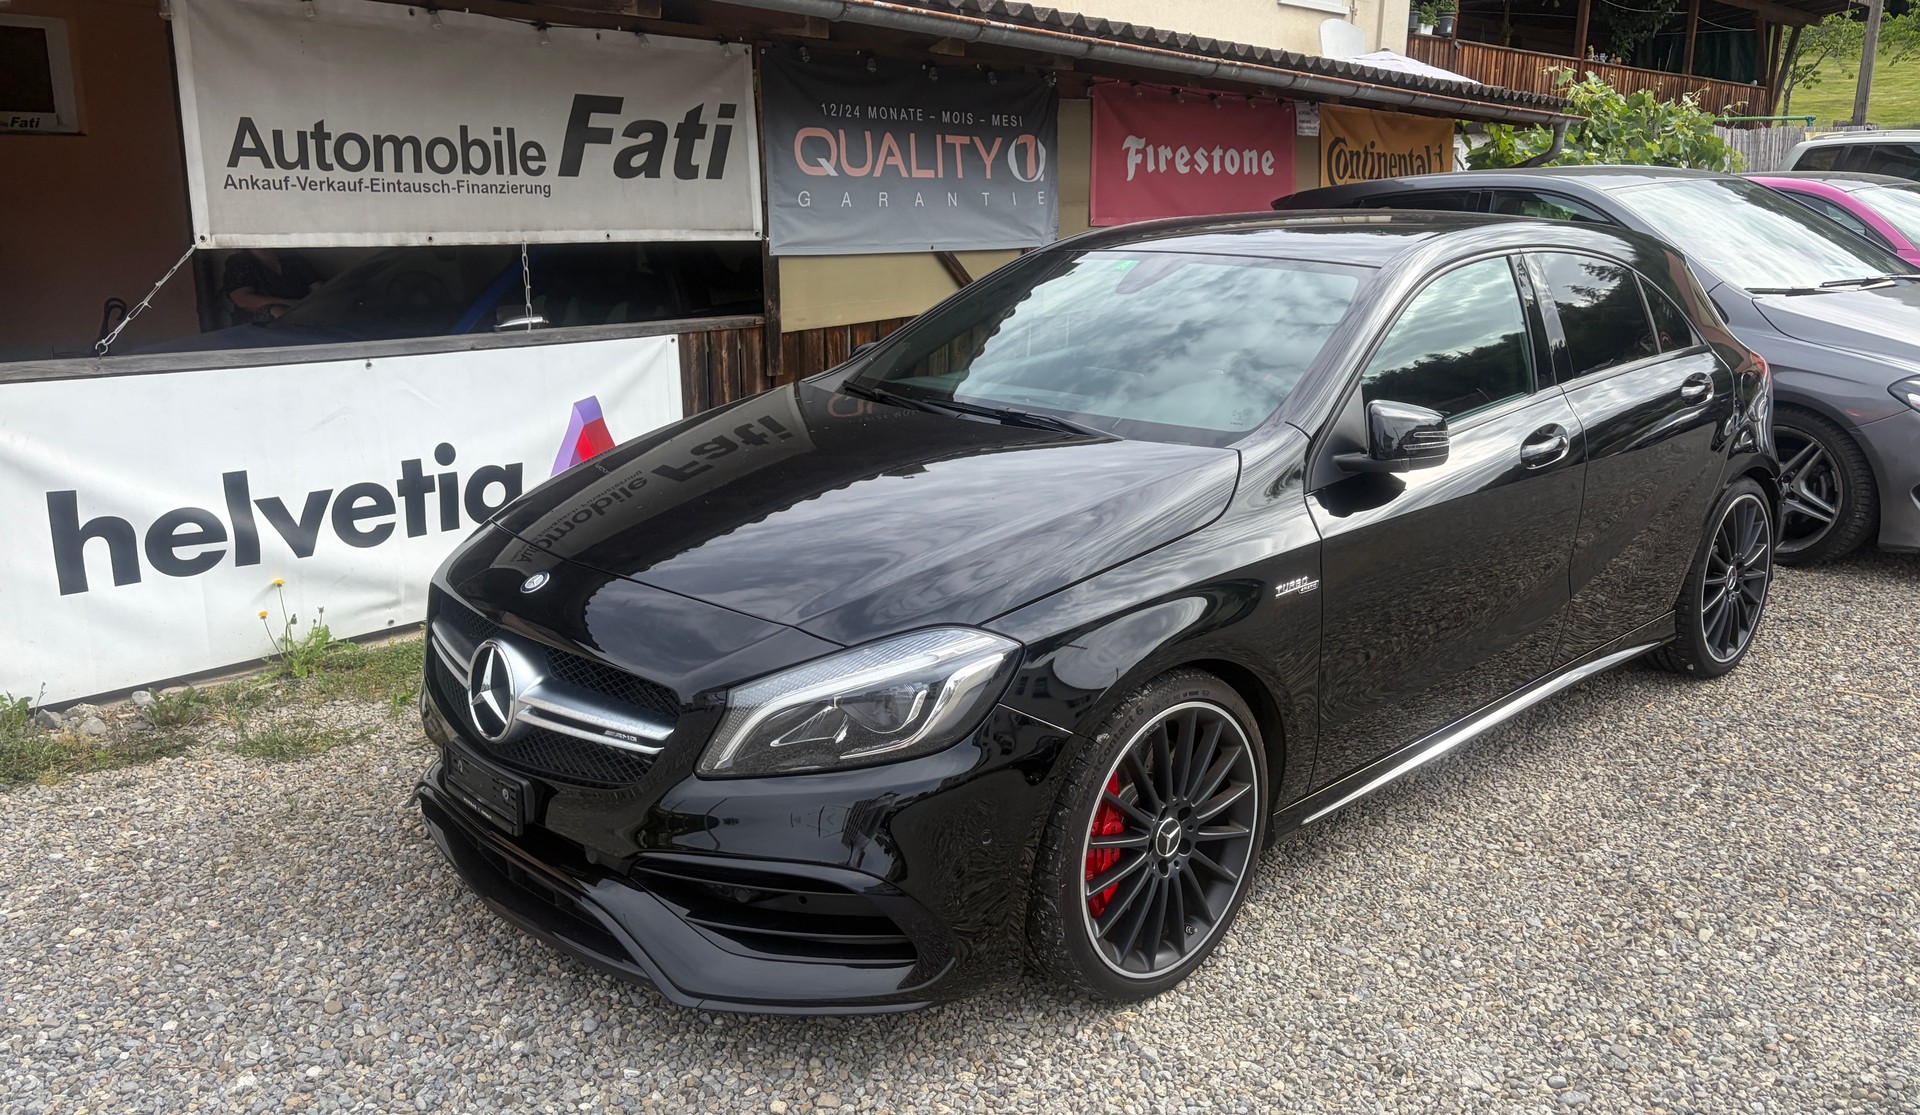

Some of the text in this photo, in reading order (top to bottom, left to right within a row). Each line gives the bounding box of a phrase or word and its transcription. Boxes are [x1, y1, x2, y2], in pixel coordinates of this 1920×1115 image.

[10, 116, 41, 128] Fati
[821, 103, 861, 118] 12/24
[868, 106, 924, 121] MONATE
[942, 111, 974, 125] MOIS
[992, 114, 1024, 127] MESI
[226, 93, 737, 180] Automobile Fati
[794, 127, 1003, 179] QUALITY
[1121, 135, 1276, 181] Firestone
[1327, 136, 1432, 186] Continental
[223, 174, 552, 198] Ankauf-Verkauf-Eintausch-Finanzierung
[797, 191, 1045, 207] GARANTIE
[46, 441, 523, 596] helvetia
[1275, 575, 1308, 595] TURBO
[614, 732, 638, 743] AMG
